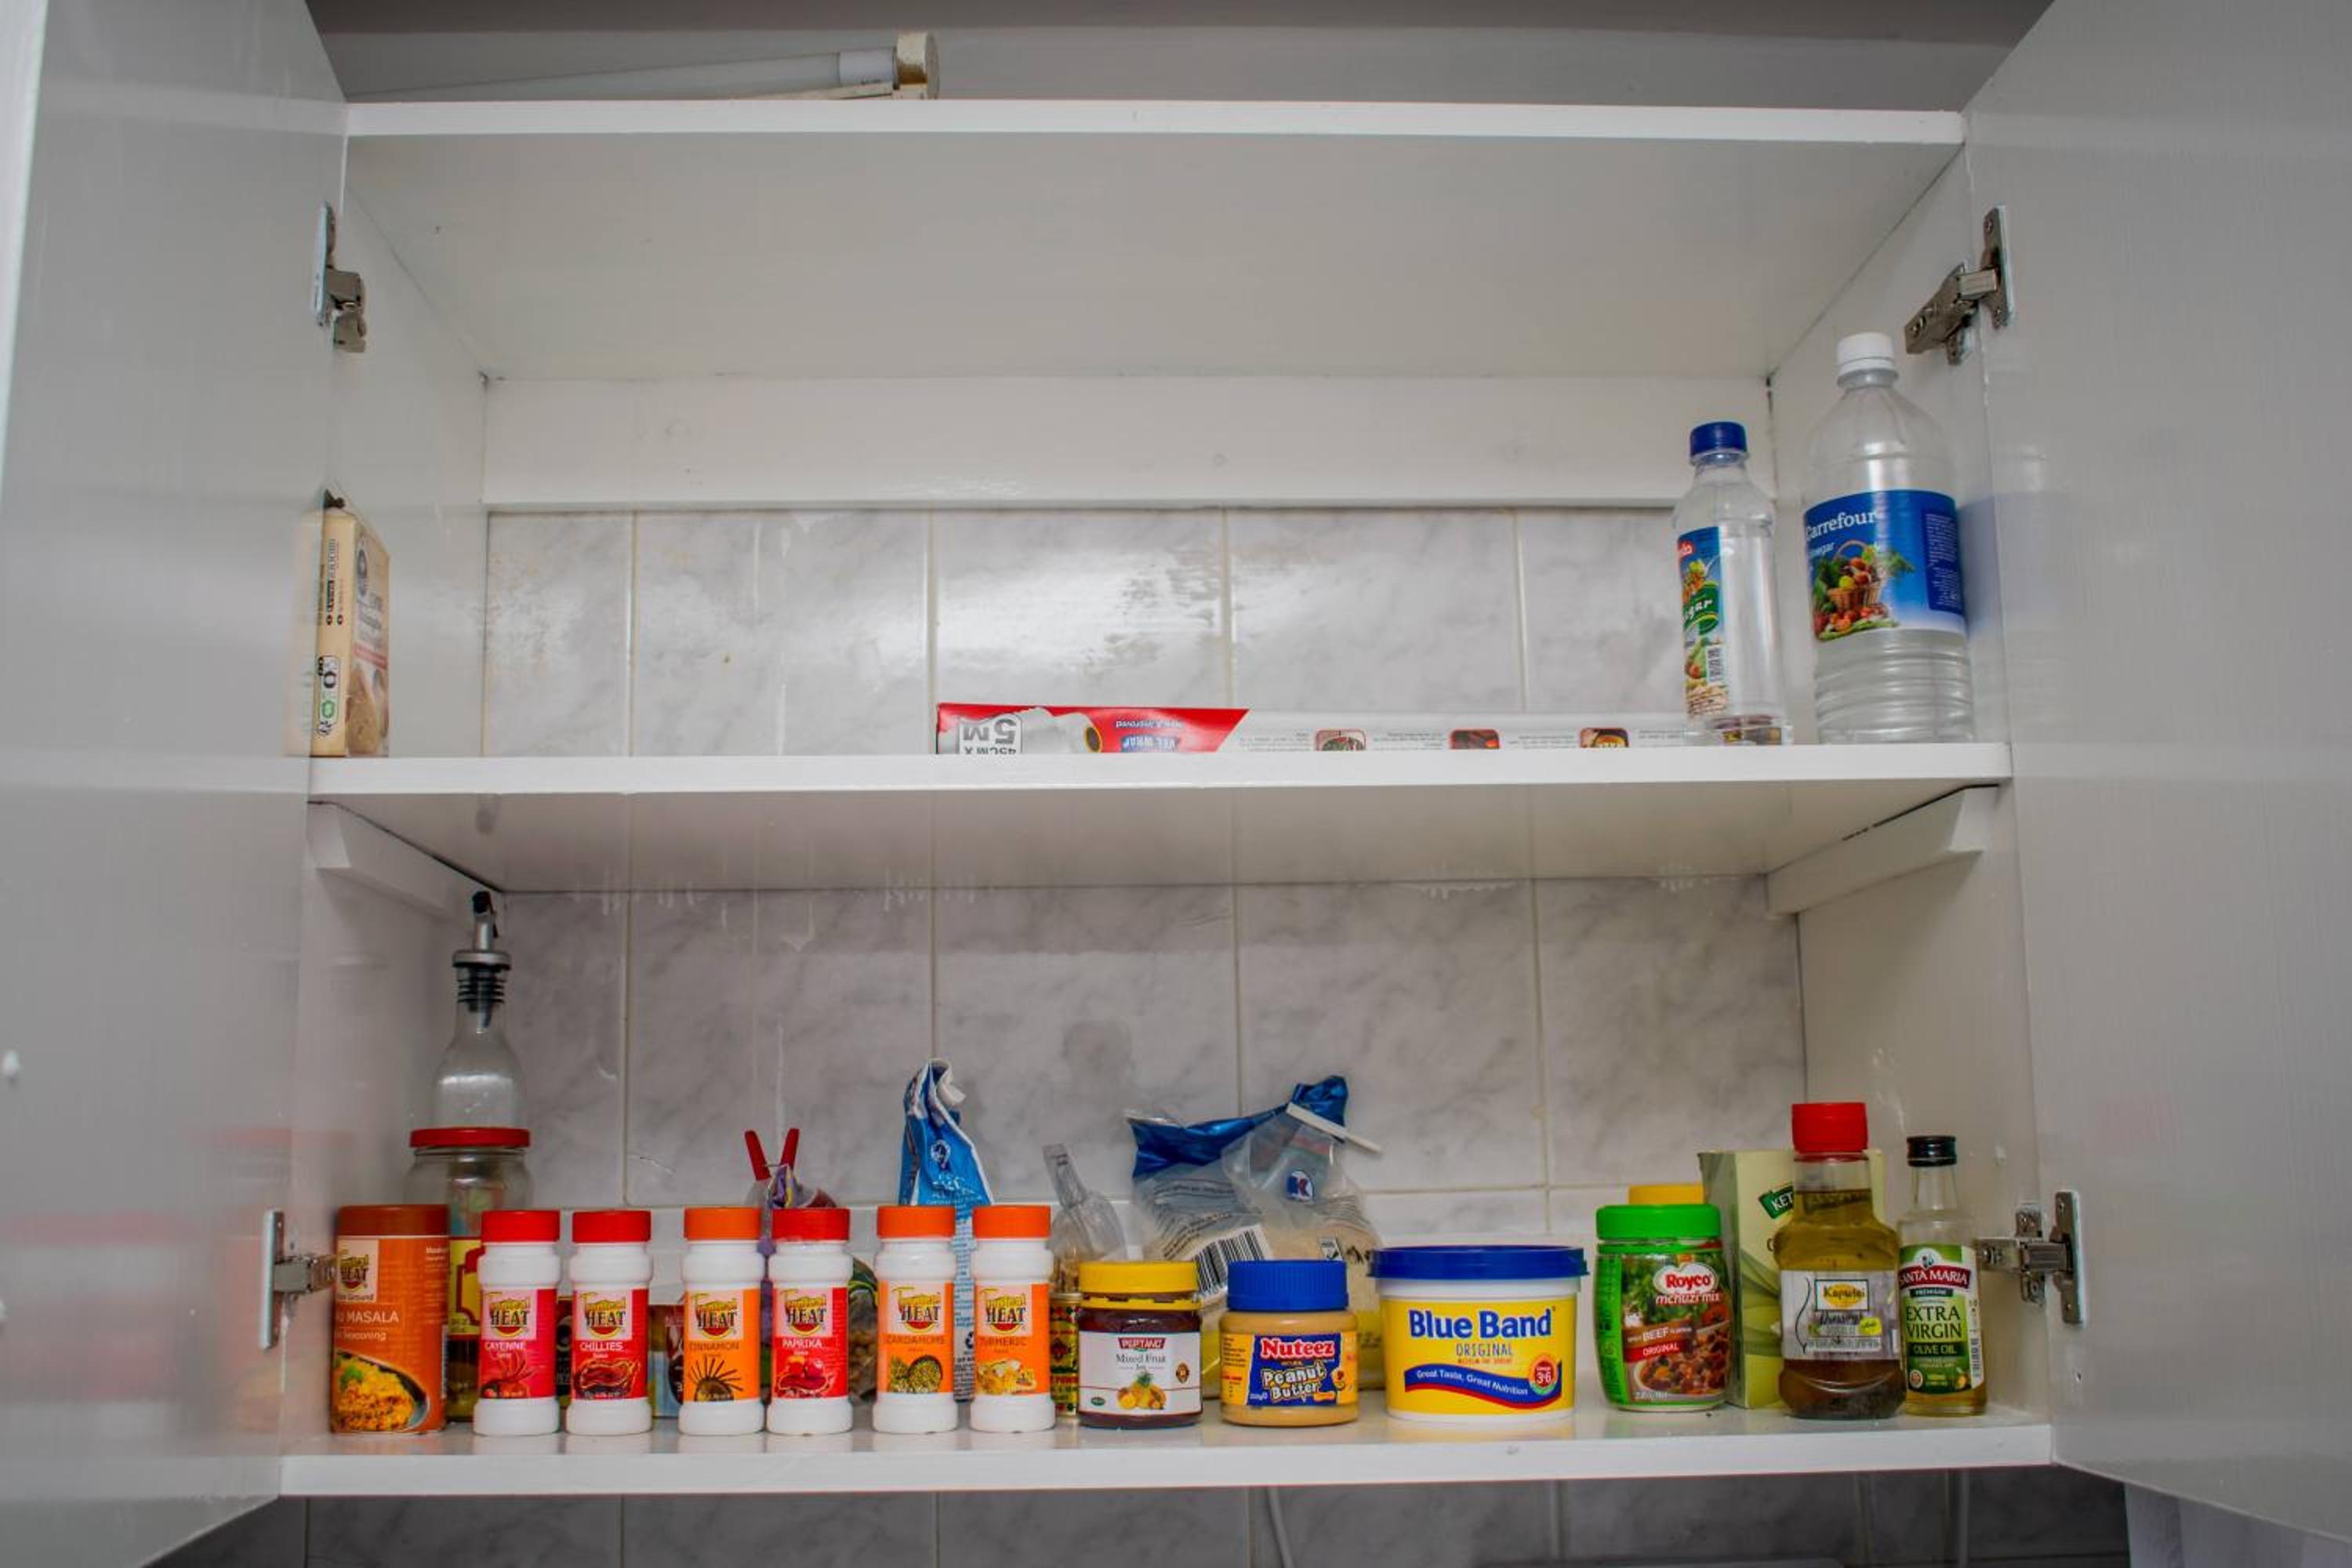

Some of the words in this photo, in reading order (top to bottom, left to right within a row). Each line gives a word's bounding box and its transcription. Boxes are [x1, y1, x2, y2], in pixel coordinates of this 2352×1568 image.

[1806, 512, 1876, 541] Carrefour
[1665, 1273, 1711, 1290] Royco
[1929, 1270, 1968, 1285] MARIA
[1656, 1291, 1700, 1305] mchuzi
[1702, 1290, 1720, 1303] mix
[347, 1310, 400, 1324] MASALA
[490, 1310, 530, 1327] HEAT
[585, 1310, 626, 1327] HEAT
[696, 1311, 738, 1328] HEAT
[786, 1307, 828, 1323] HEAT
[900, 1305, 941, 1321] HEAT
[985, 1307, 1026, 1323] HEAT
[1906, 1305, 1961, 1321] EXTRA
[1408, 1308, 1473, 1338] Blue
[1479, 1307, 1552, 1338] Band
[1642, 1327, 1670, 1342] BEEF
[1906, 1323, 1962, 1339] VIRGIN
[484, 1341, 527, 1351] CAYENNE
[579, 1341, 624, 1351] CHILLIES
[688, 1341, 740, 1352] CINNAMON
[781, 1338, 823, 1348] PAPRIKA
[1121, 1338, 1163, 1349] PEPTANG
[1261, 1338, 1334, 1358] Nuteez
[1455, 1342, 1513, 1357] ORIGINAL
[1642, 1342, 1680, 1356] ORIGINAL
[1913, 1344, 1940, 1355] OLIVE
[1940, 1345, 1958, 1355] OIL
[1116, 1352, 1144, 1363] Mixed
[1145, 1352, 1167, 1363] Fruit
[1263, 1361, 1326, 1385] Peanut
[1272, 1382, 1321, 1399] Butter
[1417, 1369, 1437, 1380] Great
[1466, 1374, 1491, 1388] Great
[1492, 1381, 1529, 1396] Nutrition
